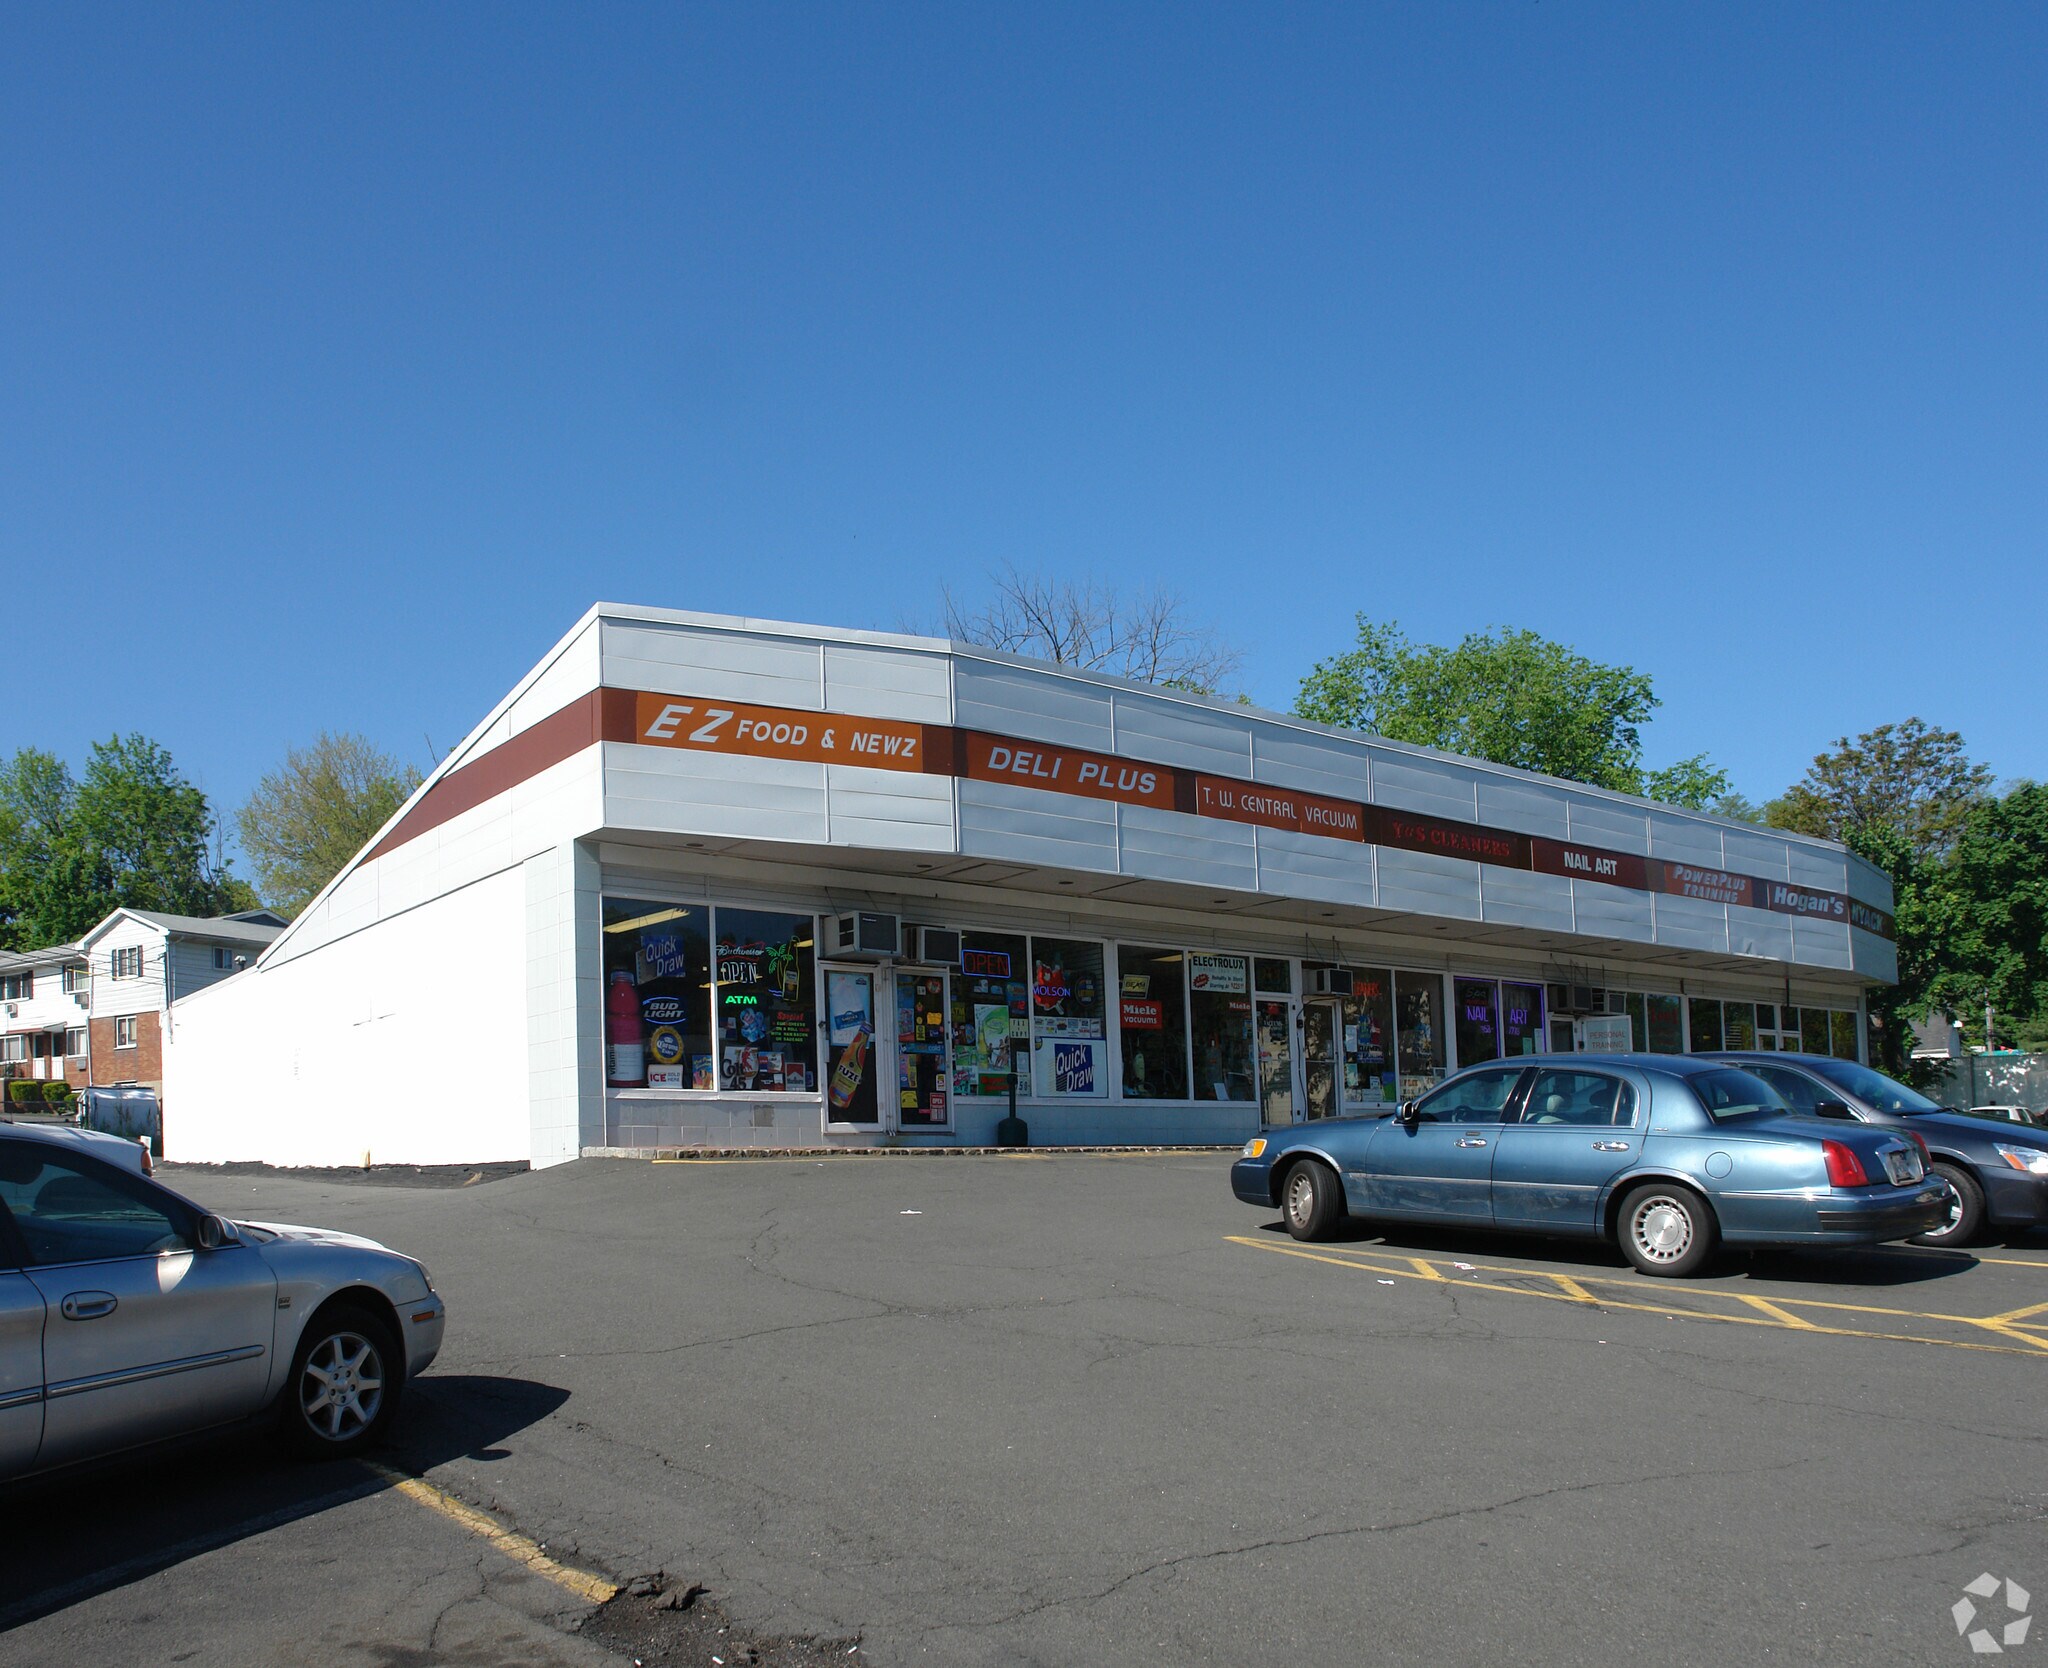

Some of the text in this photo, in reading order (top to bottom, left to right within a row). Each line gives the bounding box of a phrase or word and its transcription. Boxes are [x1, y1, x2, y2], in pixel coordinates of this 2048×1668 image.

[736, 720, 807, 745] FOOD
[821, 729, 835, 749] &
[850, 732, 917, 757] NEWZ
[988, 746, 1157, 794] DELI PLUS
[1203, 787, 1214, 804] T.
[1241, 794, 1297, 819] CENTRAL
[1304, 806, 1357, 830] VACUUM
[1430, 829, 1510, 856] CLEANERS
[1564, 851, 1617, 876] NAIL ART
[1683, 883, 1738, 903] TRAINING
[1774, 886, 1844, 915] Hogan's
[646, 936, 676, 962] Quick
[657, 954, 684, 977] Draw
[722, 962, 757, 983] OPEN
[964, 952, 1009, 976] OPEN
[1193, 955, 1244, 970] ELECTROLUX
[725, 995, 757, 1005] ATM
[1032, 985, 1071, 997] MOLSON
[644, 1010, 684, 1018] LIGHT
[650, 1002, 679, 1010] BUD
[1123, 1003, 1157, 1015] Miele
[1467, 1005, 1528, 1025] NAIL ART
[1123, 1015, 1157, 1025] vacuums
[1589, 1030, 1626, 1039] PERSONAL
[1056, 1043, 1087, 1076] Quick
[650, 1073, 667, 1083] ICE
[838, 1065, 859, 1082] FUZE
[1066, 1065, 1095, 1094] Draw
